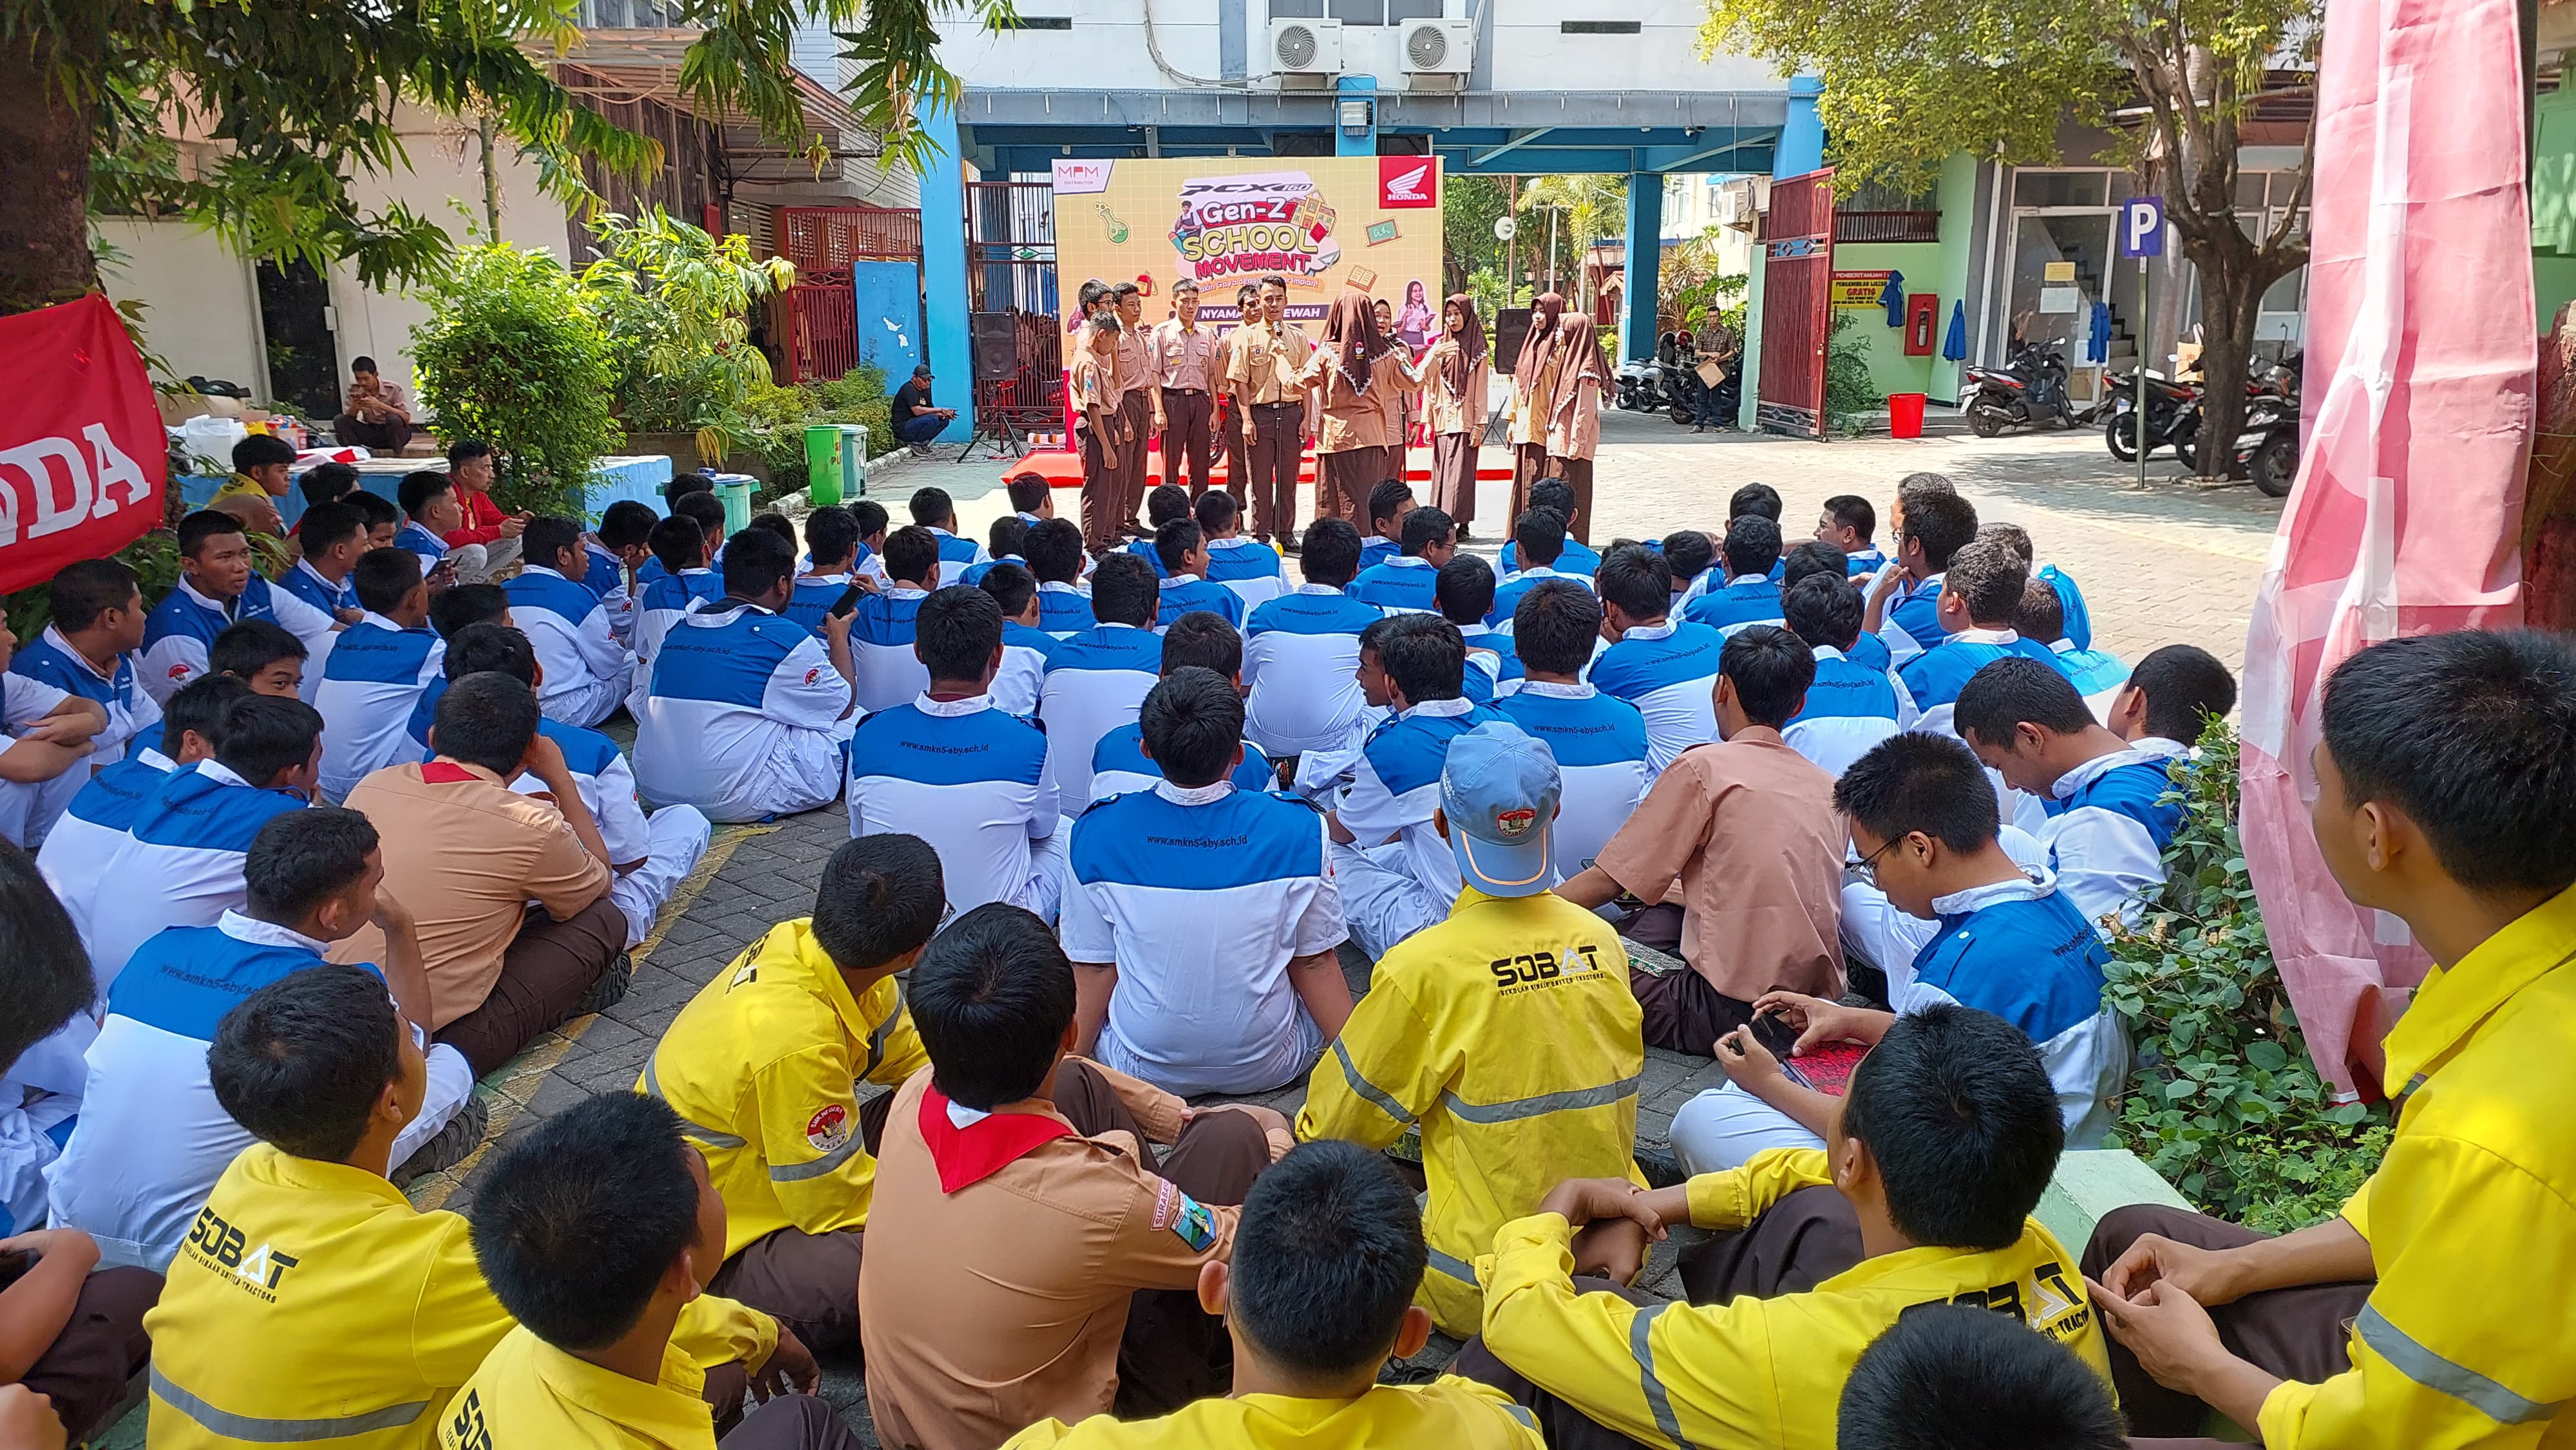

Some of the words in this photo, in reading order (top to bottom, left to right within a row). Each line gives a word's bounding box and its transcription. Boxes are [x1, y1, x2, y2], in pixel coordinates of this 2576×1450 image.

[1058, 166, 1099, 178] MPM
[1202, 196, 1287, 223] Gen-Z
[2130, 204, 2157, 250] P
[1182, 225, 1319, 261] SCHOOL
[1195, 252, 1312, 279] MOVEMENT
[1199, 285, 1215, 294] akin
[1846, 288, 1876, 296] GRATIS
[1201, 309, 1242, 319] NYAMA
[1283, 308, 1320, 319] EWAH
[1533, 722, 1616, 735] www.smkn5-sby.sch.id
[900, 740, 989, 756] www.smkn5-sby.sch.id
[1147, 834, 1247, 850] www.smkn5-sby.sch.id
[1490, 945, 1598, 988] SOBAT
[189, 1206, 300, 1290] SOBAT
